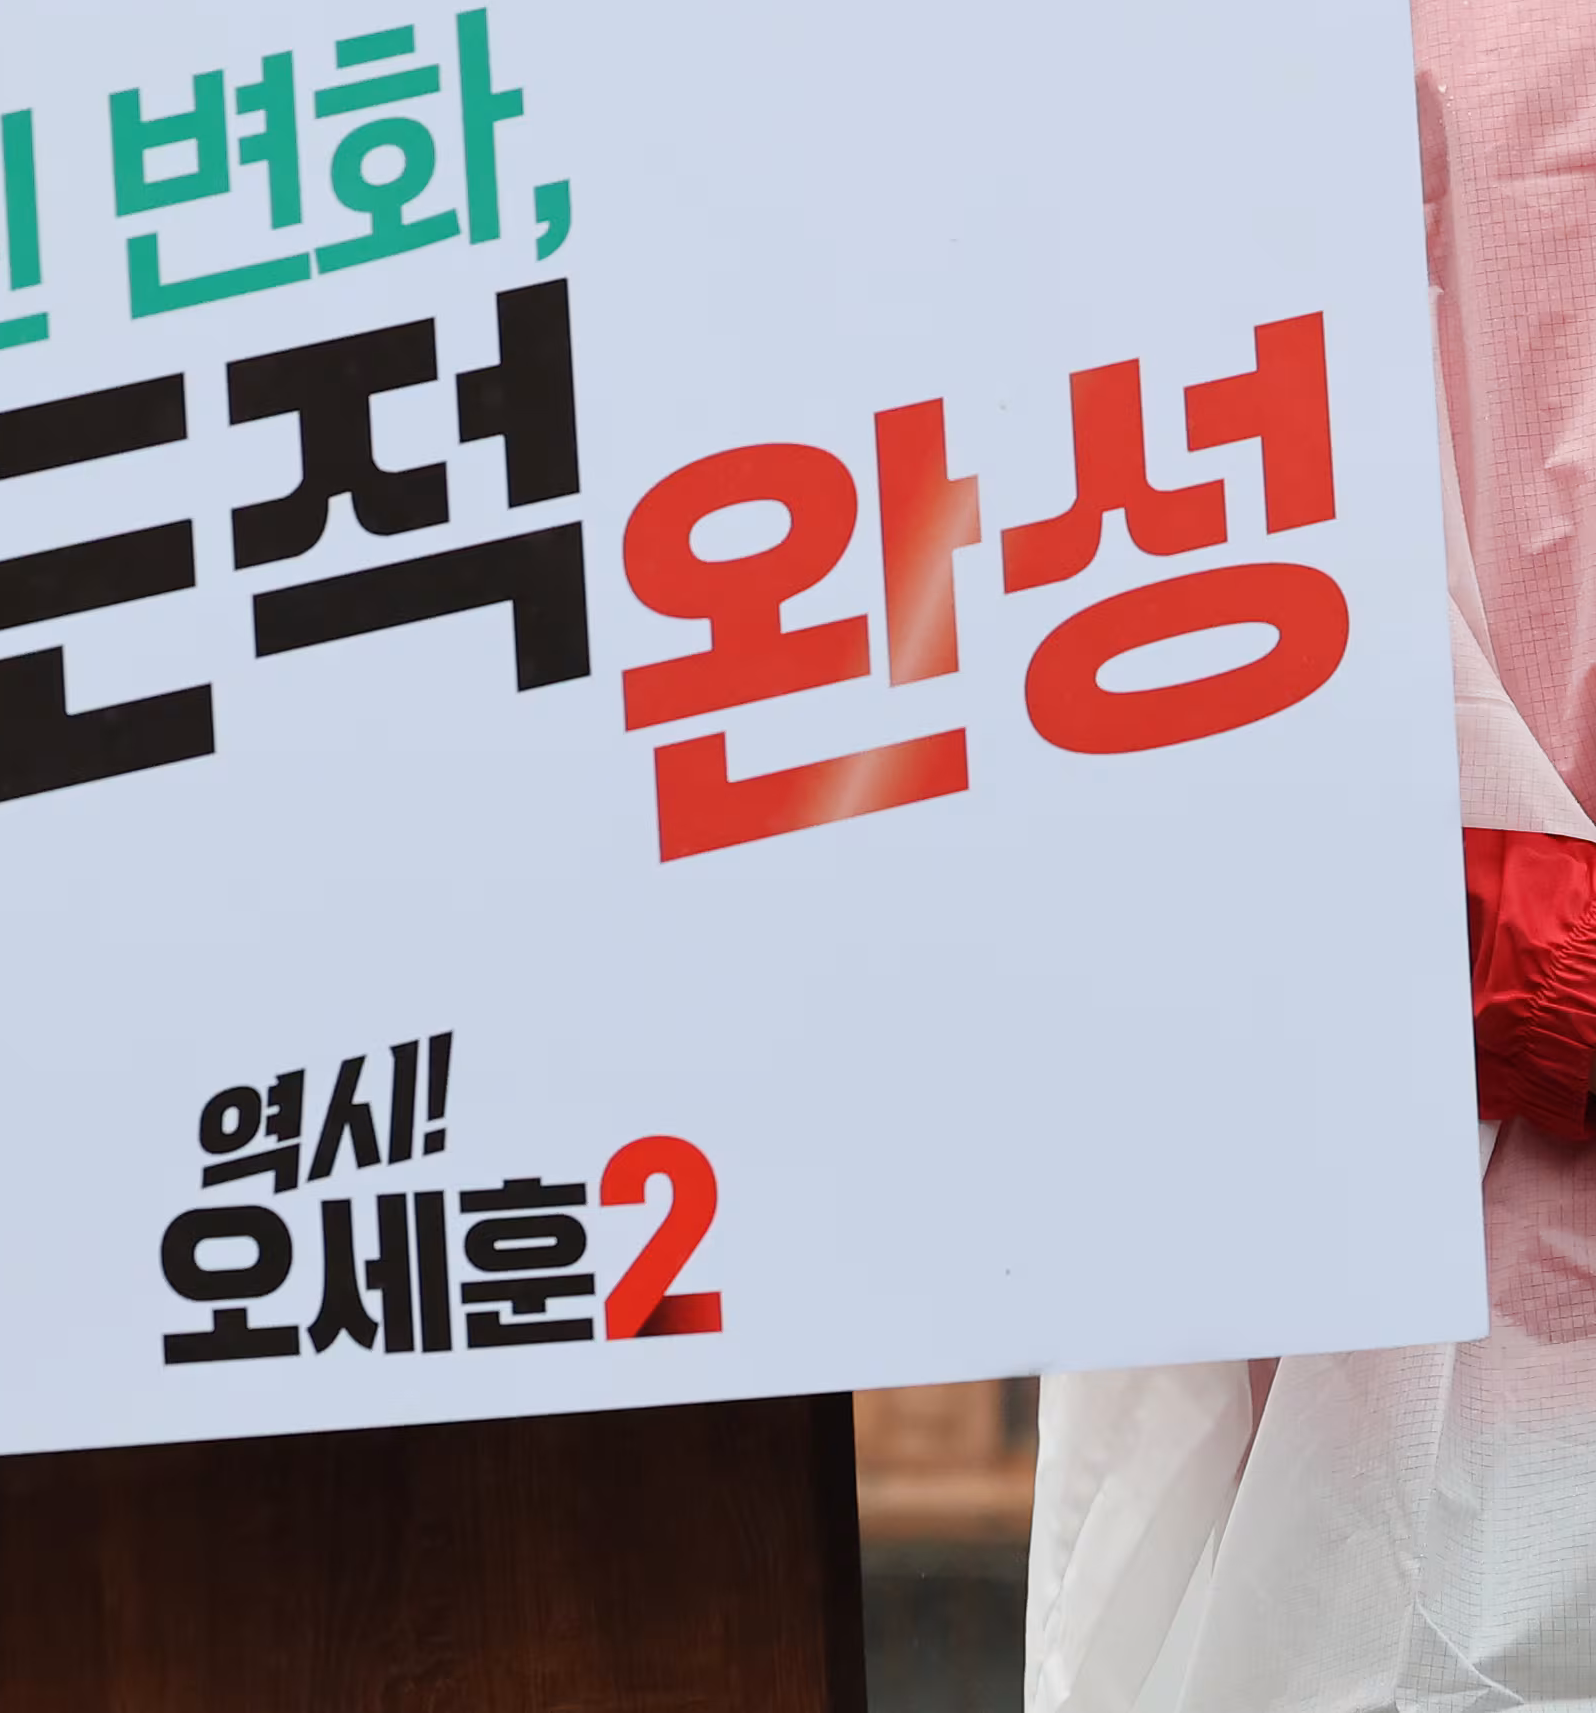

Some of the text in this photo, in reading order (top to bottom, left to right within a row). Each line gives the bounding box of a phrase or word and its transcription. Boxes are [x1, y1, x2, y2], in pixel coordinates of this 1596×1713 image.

[109, 8, 572, 320] 변화,
[622, 310, 1350, 864] 완성
[199, 1030, 453, 1194] 역시!
